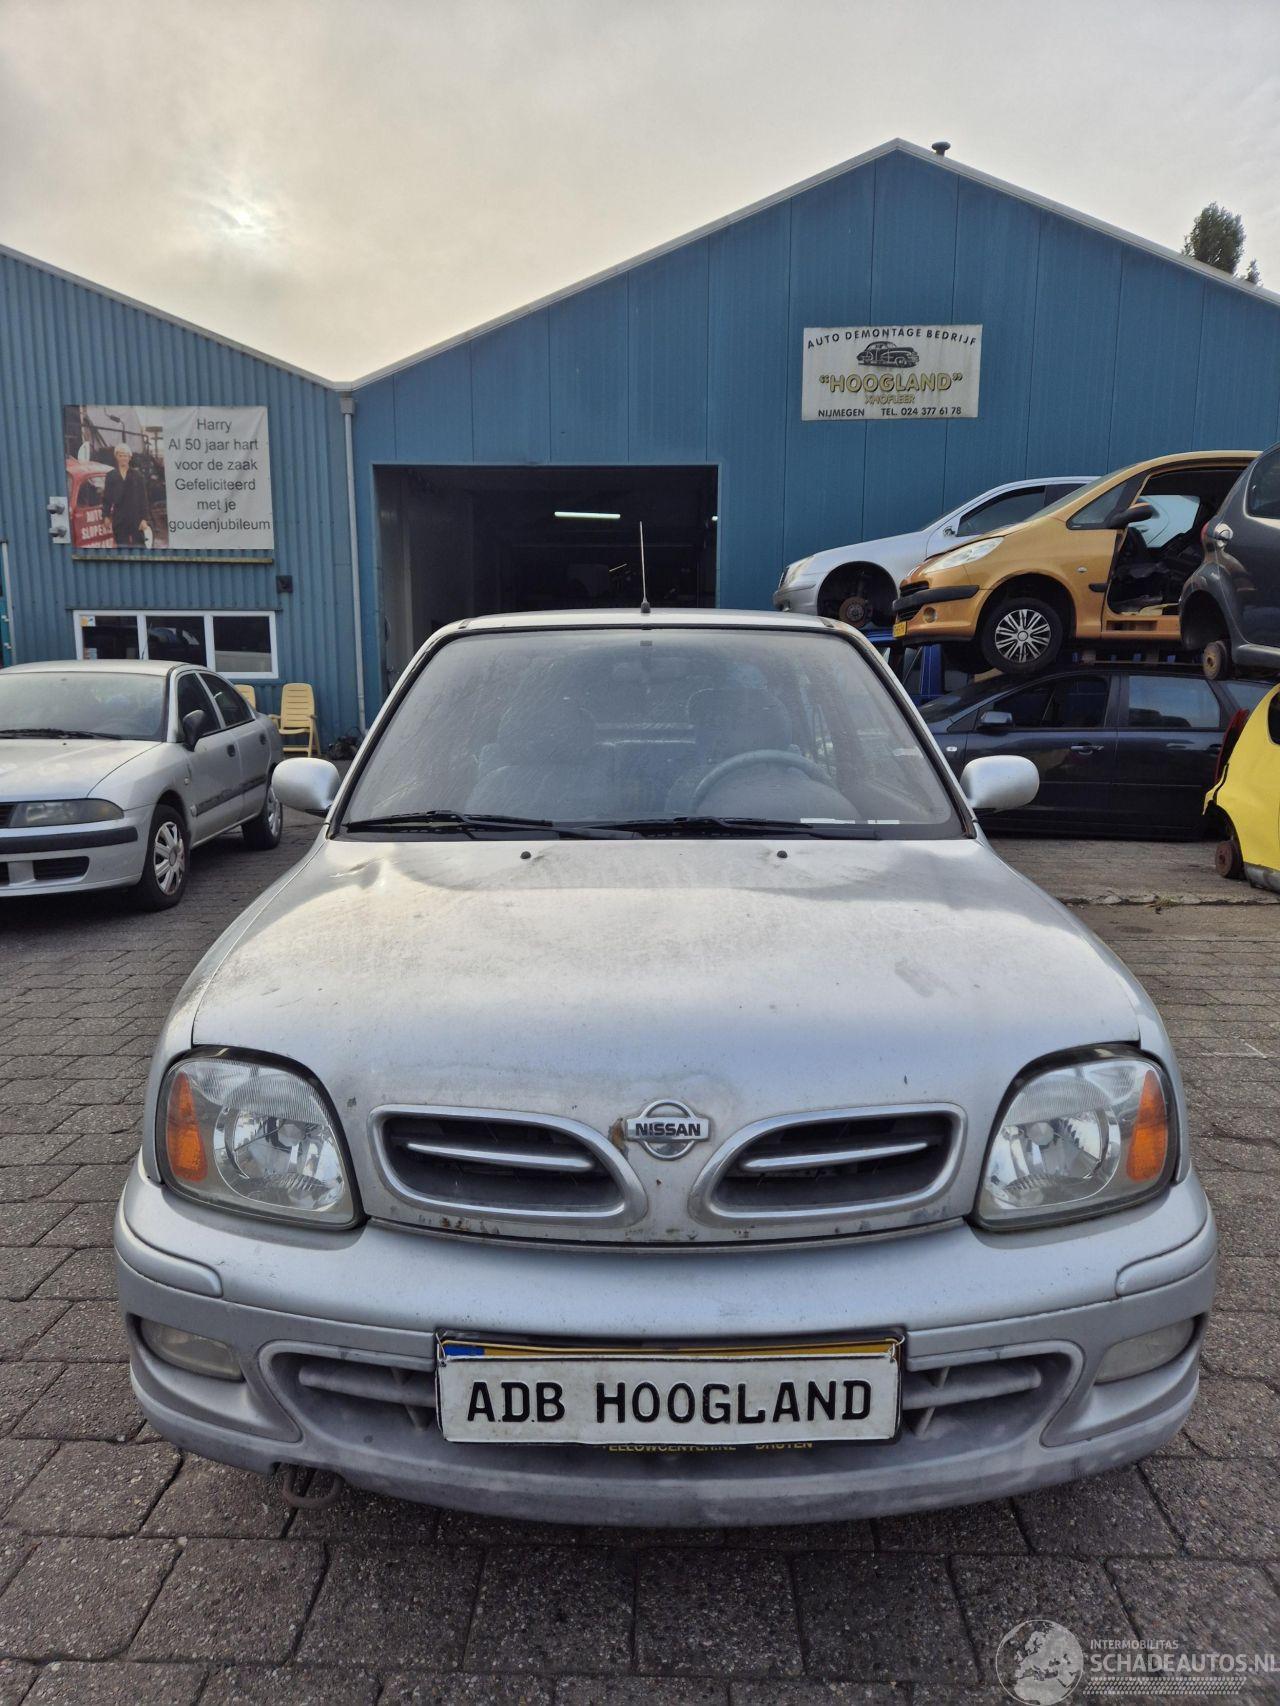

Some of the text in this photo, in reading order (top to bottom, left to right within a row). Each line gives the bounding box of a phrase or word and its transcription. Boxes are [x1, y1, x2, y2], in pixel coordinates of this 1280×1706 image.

[807, 328, 977, 349] AUTO DEMONTAGE BEDRIJF
[818, 406, 962, 417] NIJMEGEN TEL. 024 377 61 78
[197, 418, 232, 433] Harry
[168, 438, 259, 454] Al 50 jaar hart
[175, 458, 258, 471] voor de zaak
[175, 478, 256, 491] Gefeliciteerd
[197, 497, 236, 513] met je
[169, 518, 271, 533] goudenjubileum
[635, 1122, 701, 1136] NISSAN
[596, 1379, 871, 1424] HOOGLAND
